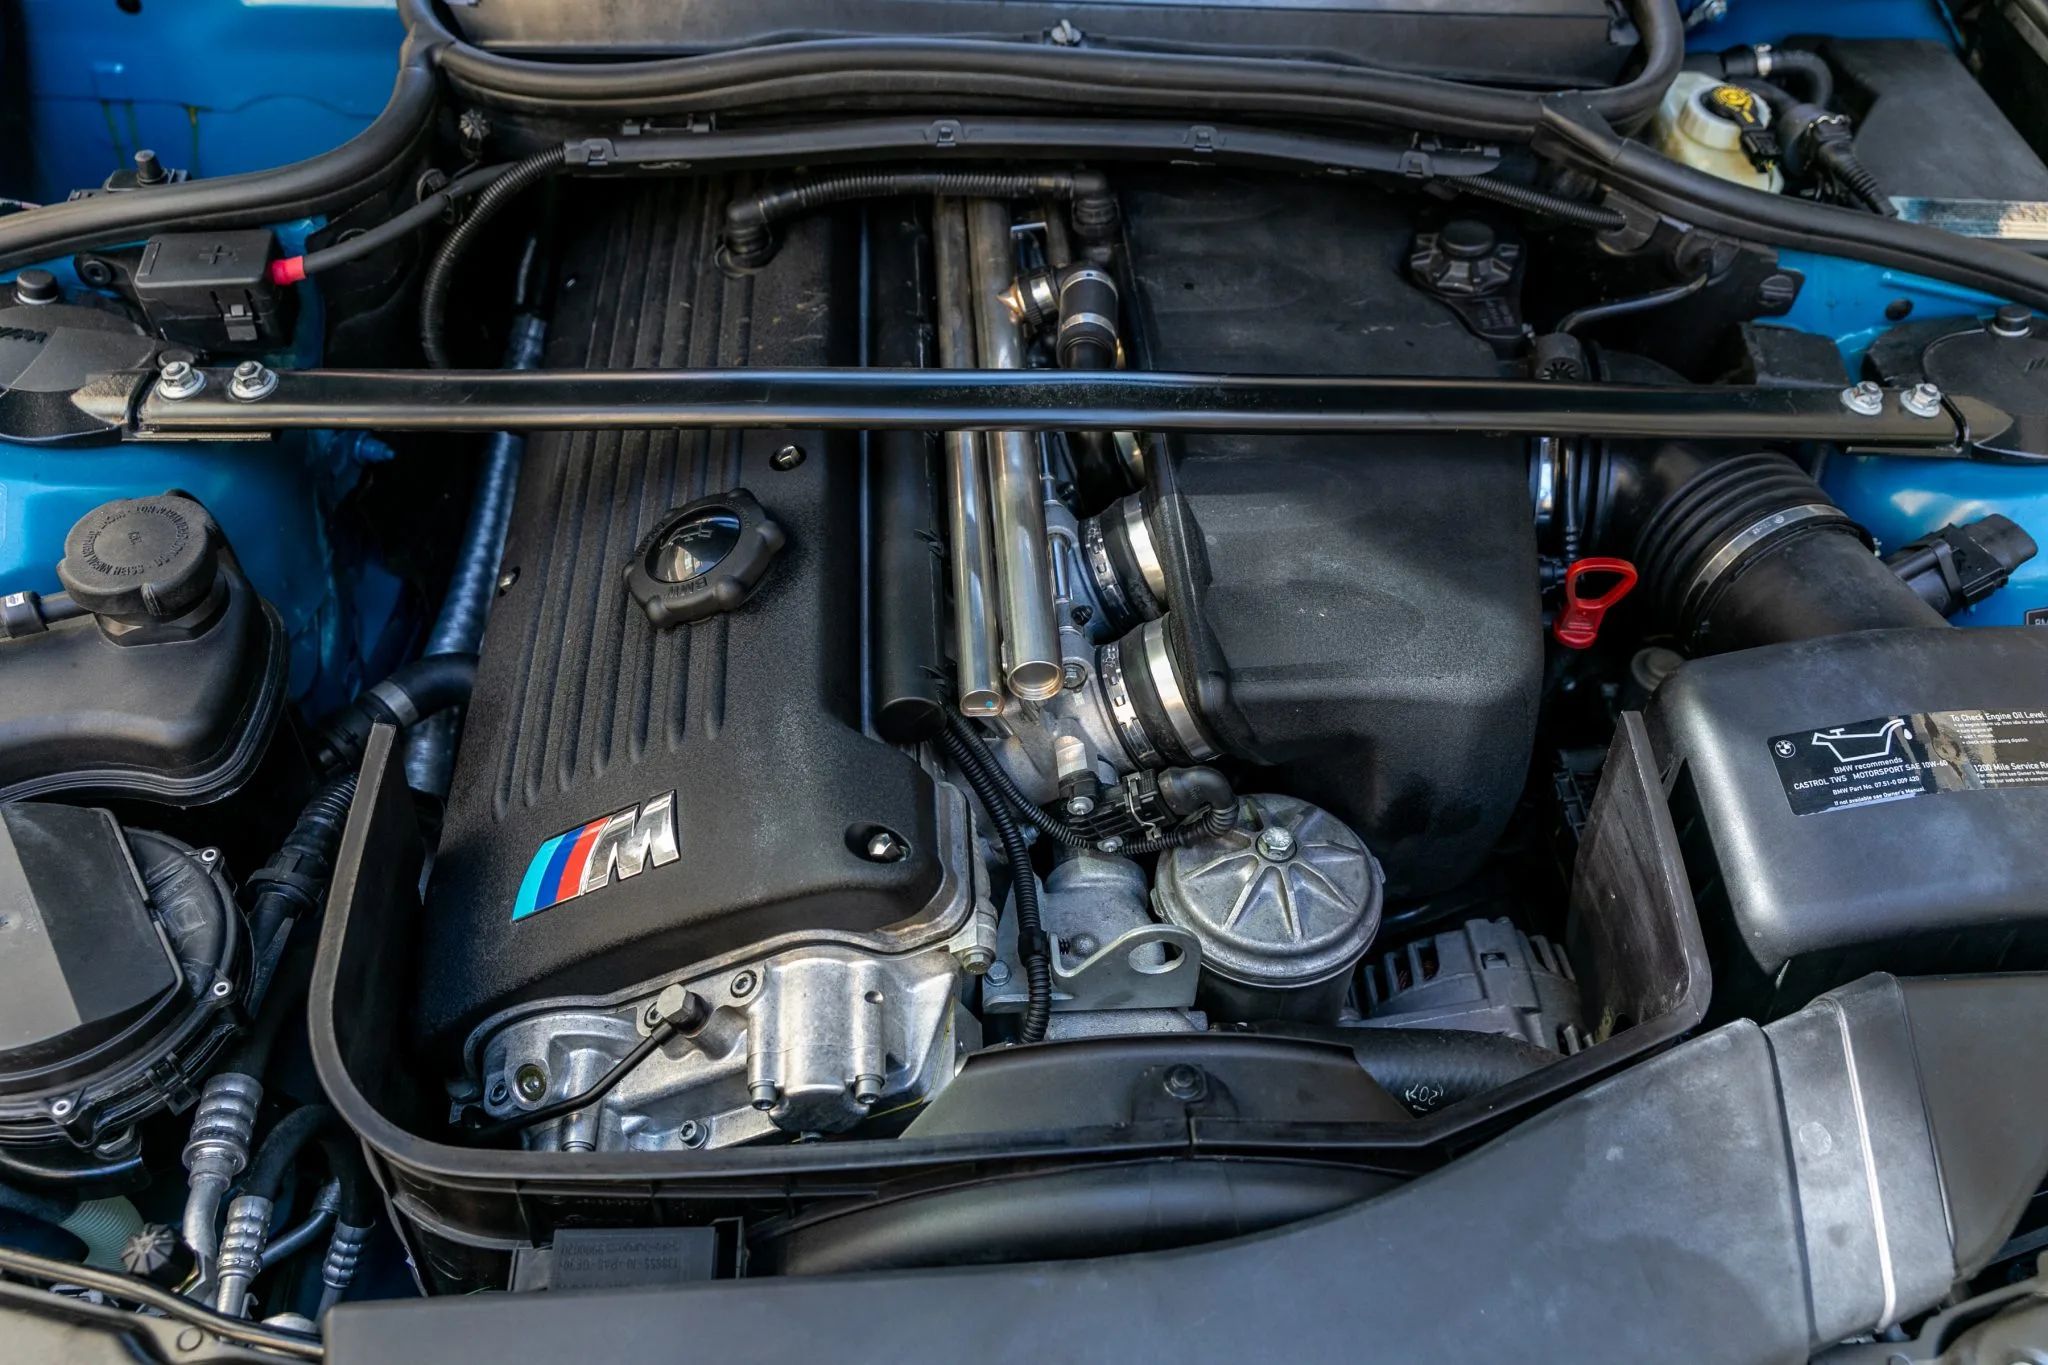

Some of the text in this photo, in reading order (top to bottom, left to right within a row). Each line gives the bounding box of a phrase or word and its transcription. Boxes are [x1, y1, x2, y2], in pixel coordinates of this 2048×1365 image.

[1951, 710, 2047, 722] To Check Engine Oil Level:
[1833, 757, 1903, 774] BMW recommends
[1973, 763, 1993, 772] 1200
[1993, 763, 2010, 771] Mile
[2010, 761, 2040, 770] Service
[1794, 760, 1949, 790] CASTROL TWS MOTORSPORT SAE 10W-60
[1832, 786, 1849, 796] BMW
[1849, 784, 1862, 793] Part
[1863, 782, 1873, 790] No.
[1849, 795, 1872, 804] available
[1883, 790, 1905, 798] Owner's
[580, 790, 680, 896] M
